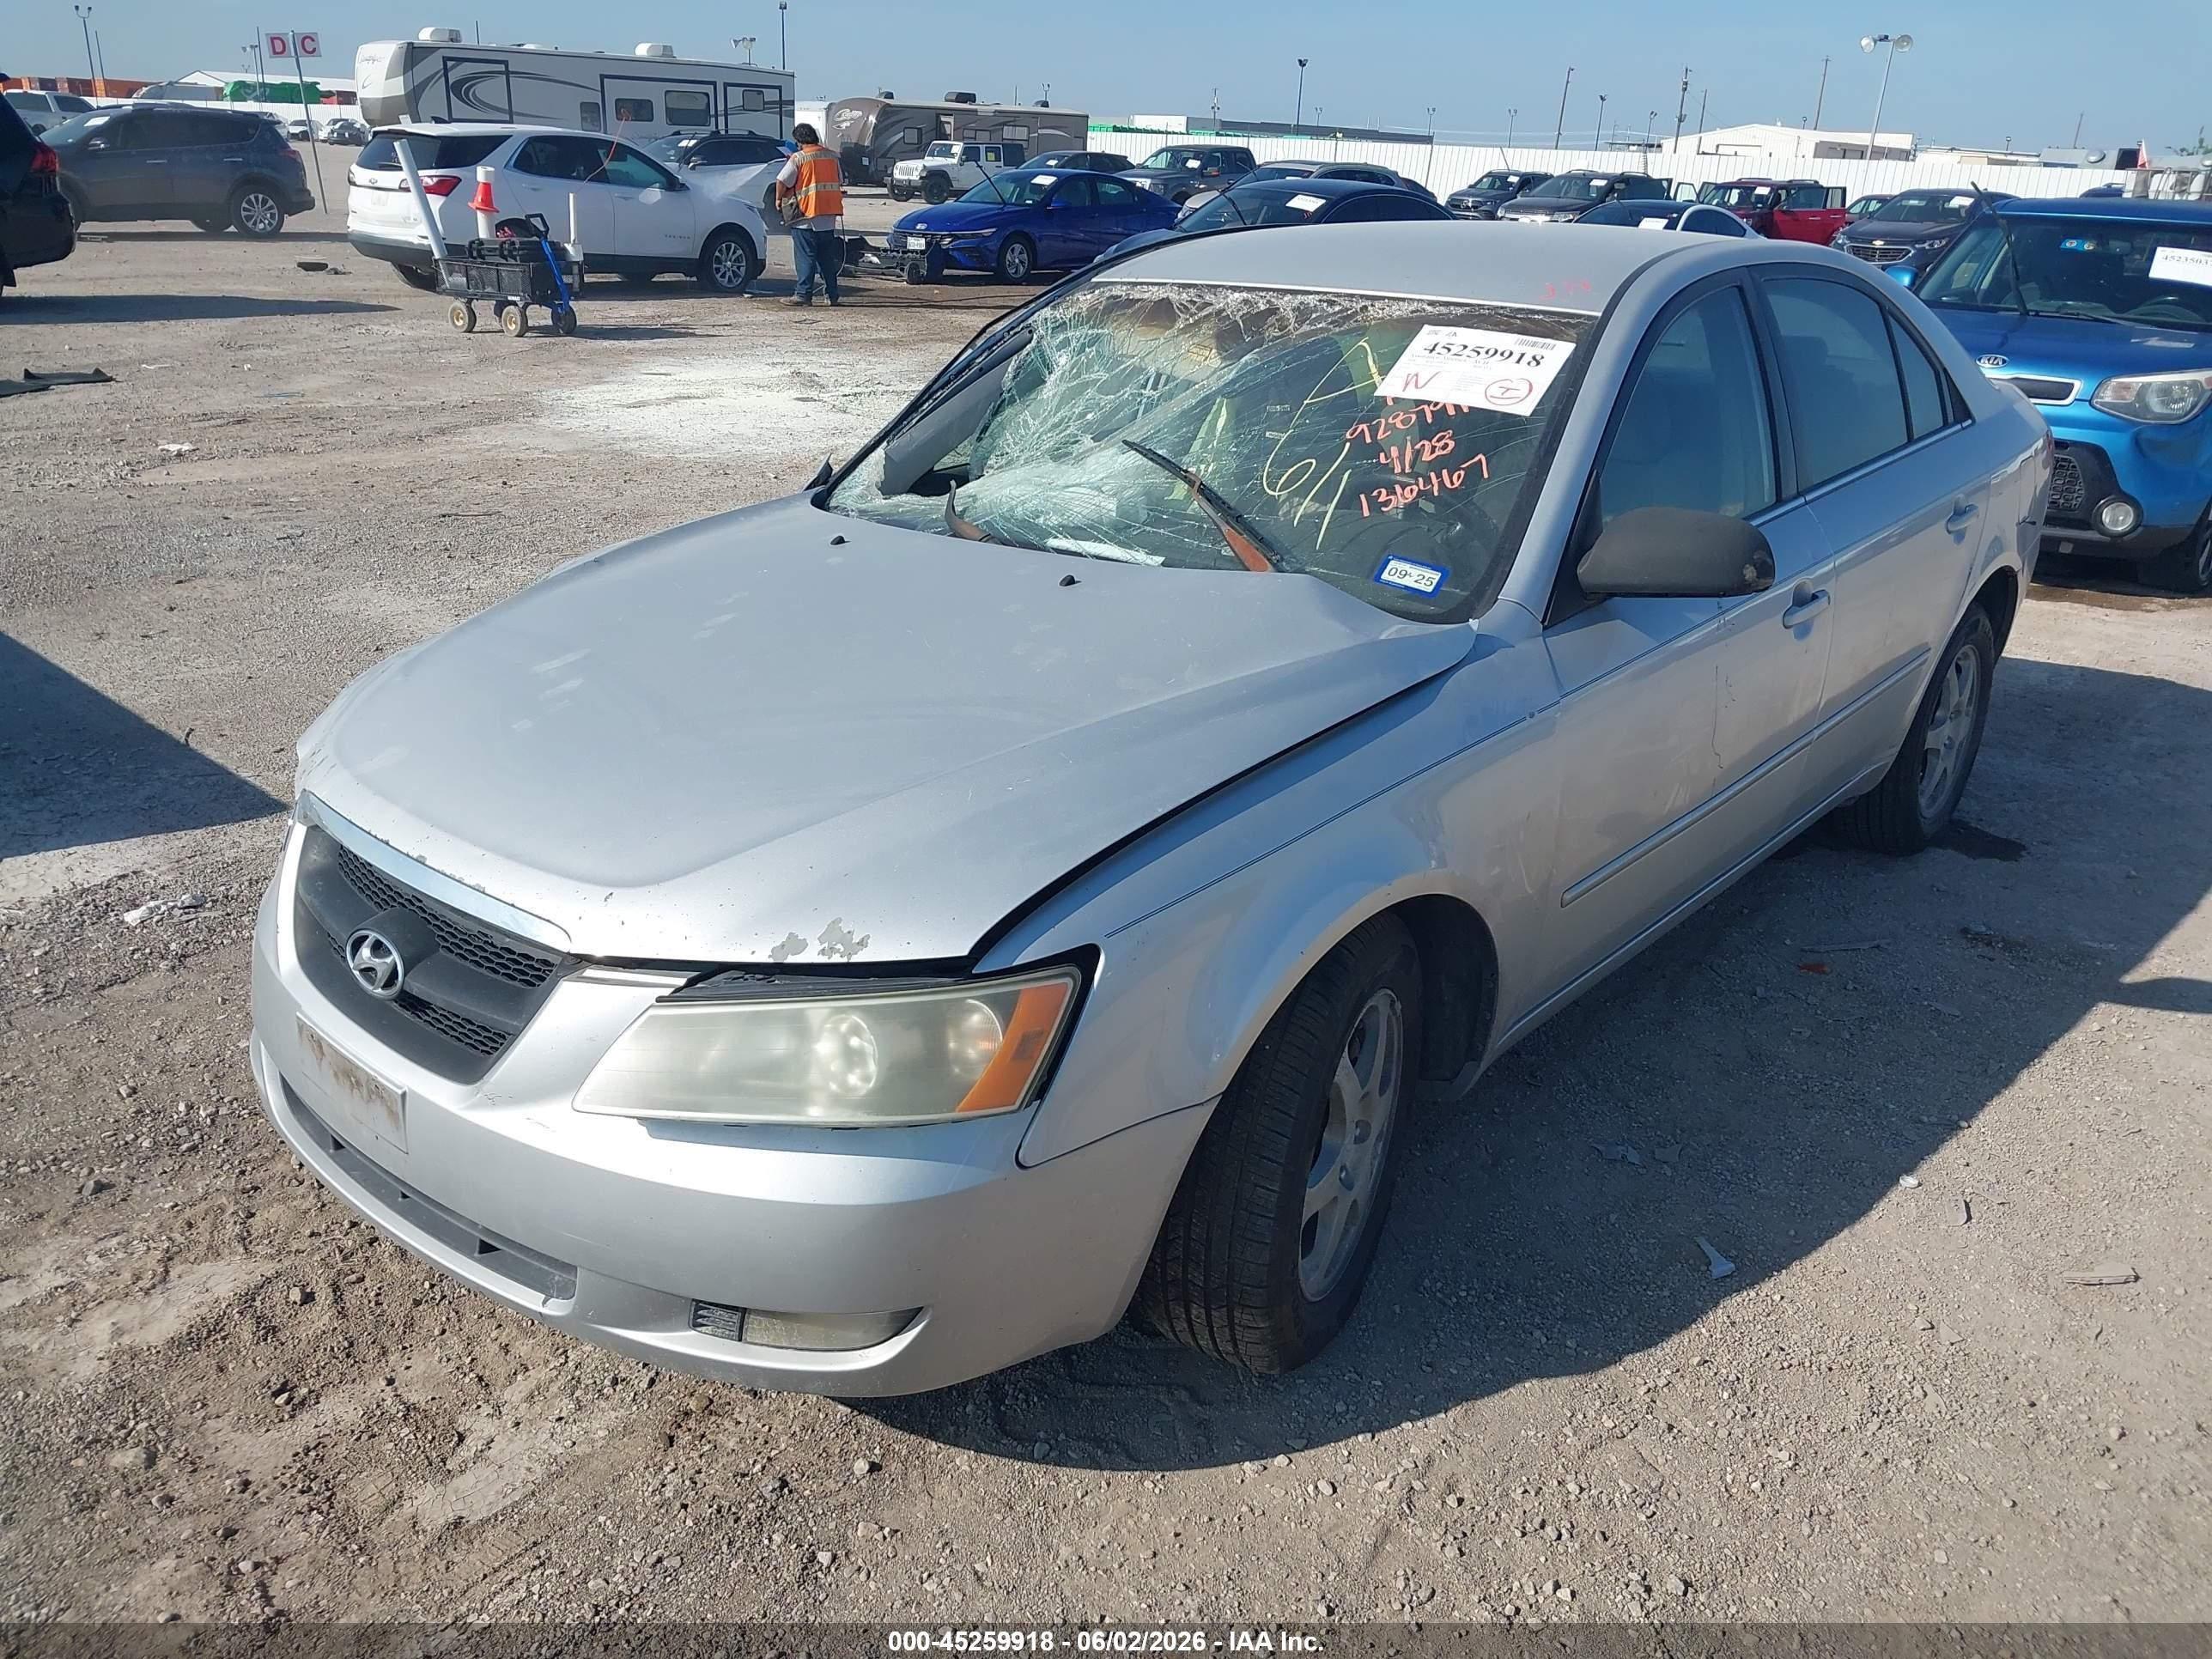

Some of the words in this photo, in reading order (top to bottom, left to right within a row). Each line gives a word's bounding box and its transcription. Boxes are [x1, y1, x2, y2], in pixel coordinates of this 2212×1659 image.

[270, 36, 286, 55] D
[301, 35, 317, 55] C
[1423, 341, 1545, 368] 45259918
[1980, 356, 2002, 366] KIA
[1378, 430, 1455, 474] 4/28
[1387, 567, 1408, 580] 09
[1413, 574, 1437, 587] 25
